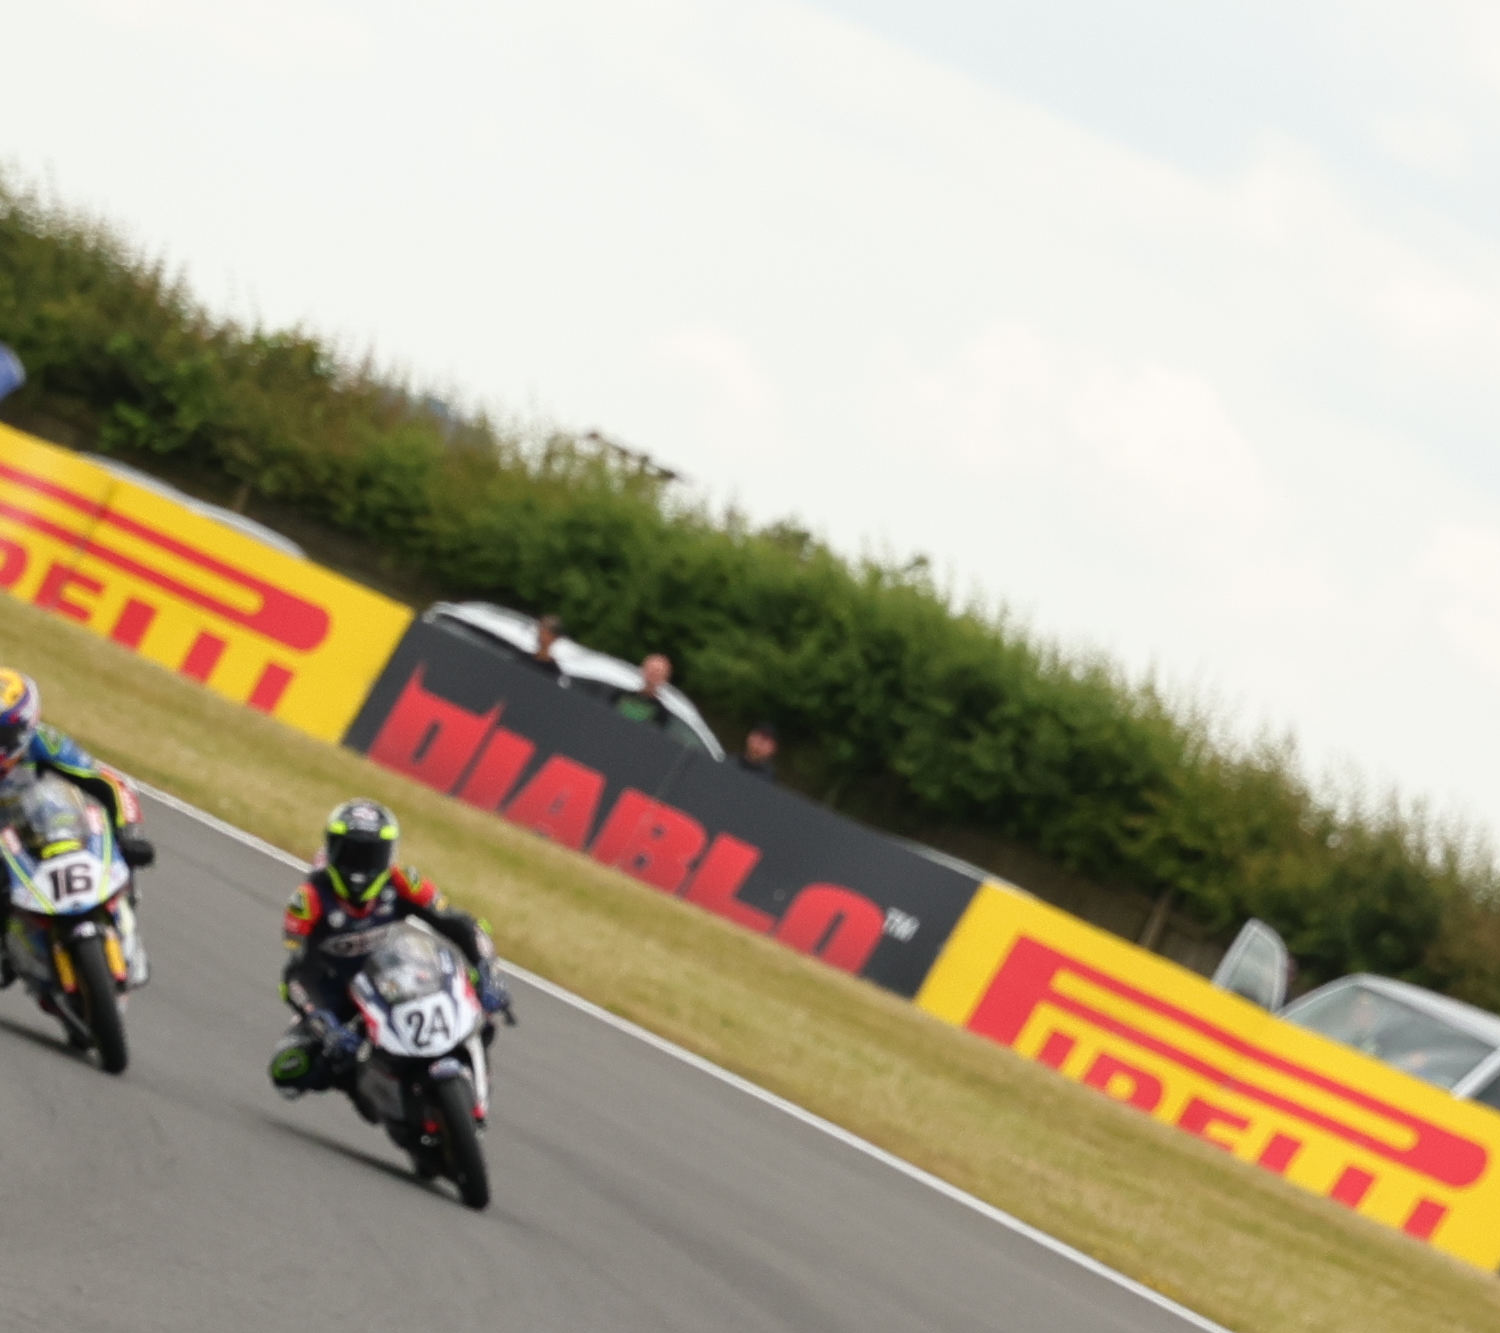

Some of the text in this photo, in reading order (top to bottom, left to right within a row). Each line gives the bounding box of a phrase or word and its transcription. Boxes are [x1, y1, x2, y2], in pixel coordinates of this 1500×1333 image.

[368, 663, 920, 975] DIABLO TM
[47, 863, 93, 903] 16
[406, 1004, 451, 1048] 24
